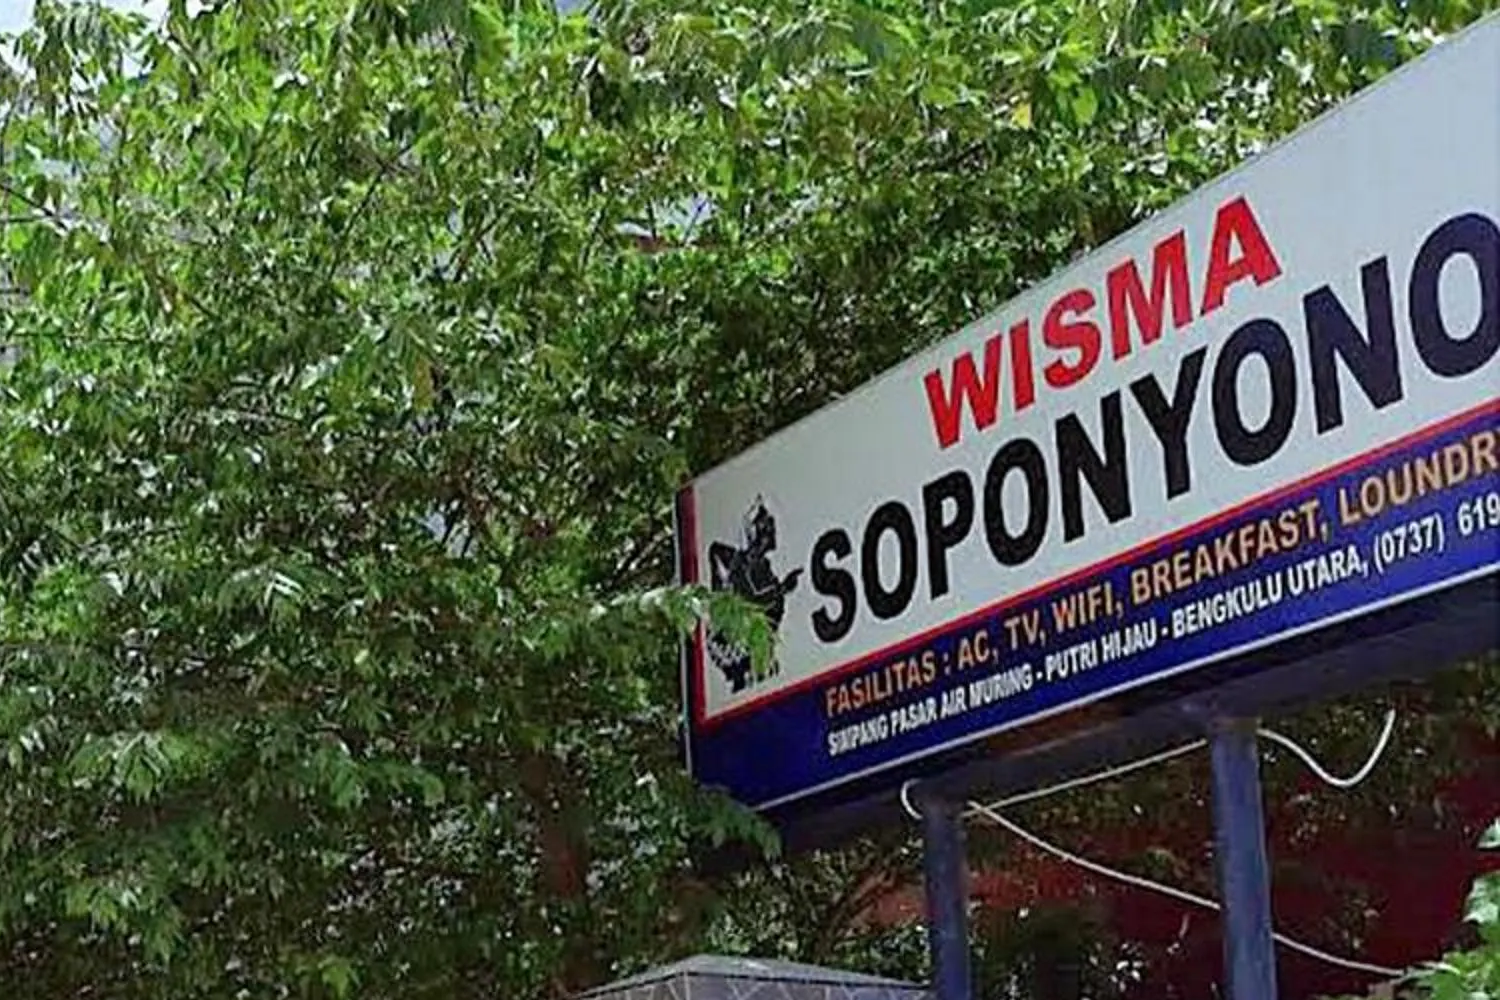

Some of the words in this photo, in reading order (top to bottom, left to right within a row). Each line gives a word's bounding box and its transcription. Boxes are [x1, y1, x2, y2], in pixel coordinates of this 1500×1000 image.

[810, 213, 1500, 645] SOPONYONO
[923, 196, 1282, 450] WISMA
[826, 651, 936, 717] FASILITAS
[958, 630, 999, 670] AC,
[1004, 608, 1046, 649] TV,
[1052, 581, 1124, 633] WIFI,
[1131, 499, 1328, 605] BREAKFAST,
[1338, 427, 1500, 526] LOUNDR
[827, 714, 890, 756] SIMPANG
[891, 697, 938, 736] PASAR
[940, 686, 968, 720] AIR
[969, 663, 1034, 709] MURING
[1045, 639, 1099, 682] PUTRI
[1101, 617, 1158, 663] HIJAU
[1171, 570, 1283, 640] BENGKULU
[1286, 544, 1369, 597] UTARA,
[1373, 512, 1444, 575] (0737)
